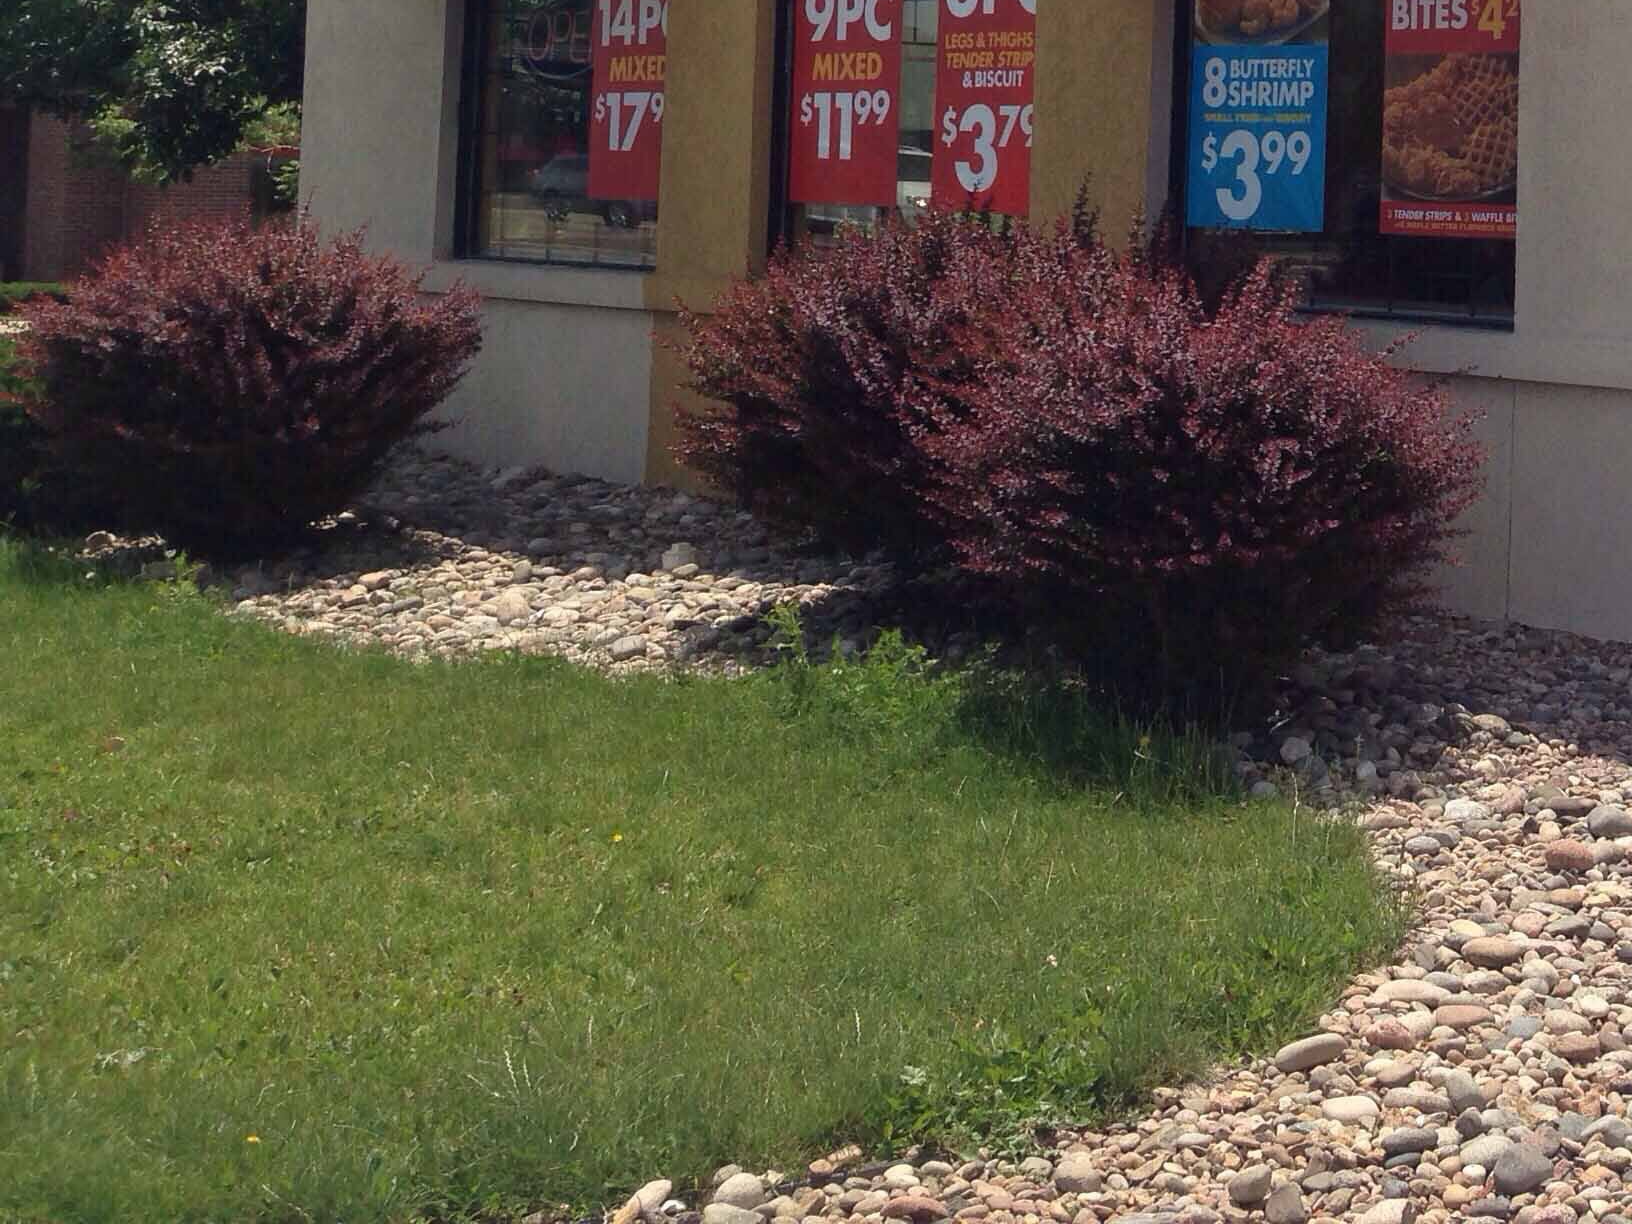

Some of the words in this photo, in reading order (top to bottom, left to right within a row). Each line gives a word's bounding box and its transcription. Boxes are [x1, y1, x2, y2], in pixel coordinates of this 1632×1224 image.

[528, 7, 594, 64] OPE
[945, 33, 974, 50] LEGS
[976, 31, 986, 49] &
[987, 30, 1034, 49] THIGHS
[812, 52, 883, 81] MIXED
[945, 51, 995, 70] TENDER
[962, 71, 973, 89] &
[975, 69, 1025, 88] BISCUIT
[1202, 56, 1228, 109] 8
[1230, 58, 1316, 79] BUTTERFLY
[1227, 80, 1315, 107] SHRIMP
[1393, 208, 1424, 221] TENDER
[1425, 209, 1454, 222] STRIPS
[1471, 211, 1503, 223] WAFFLE
